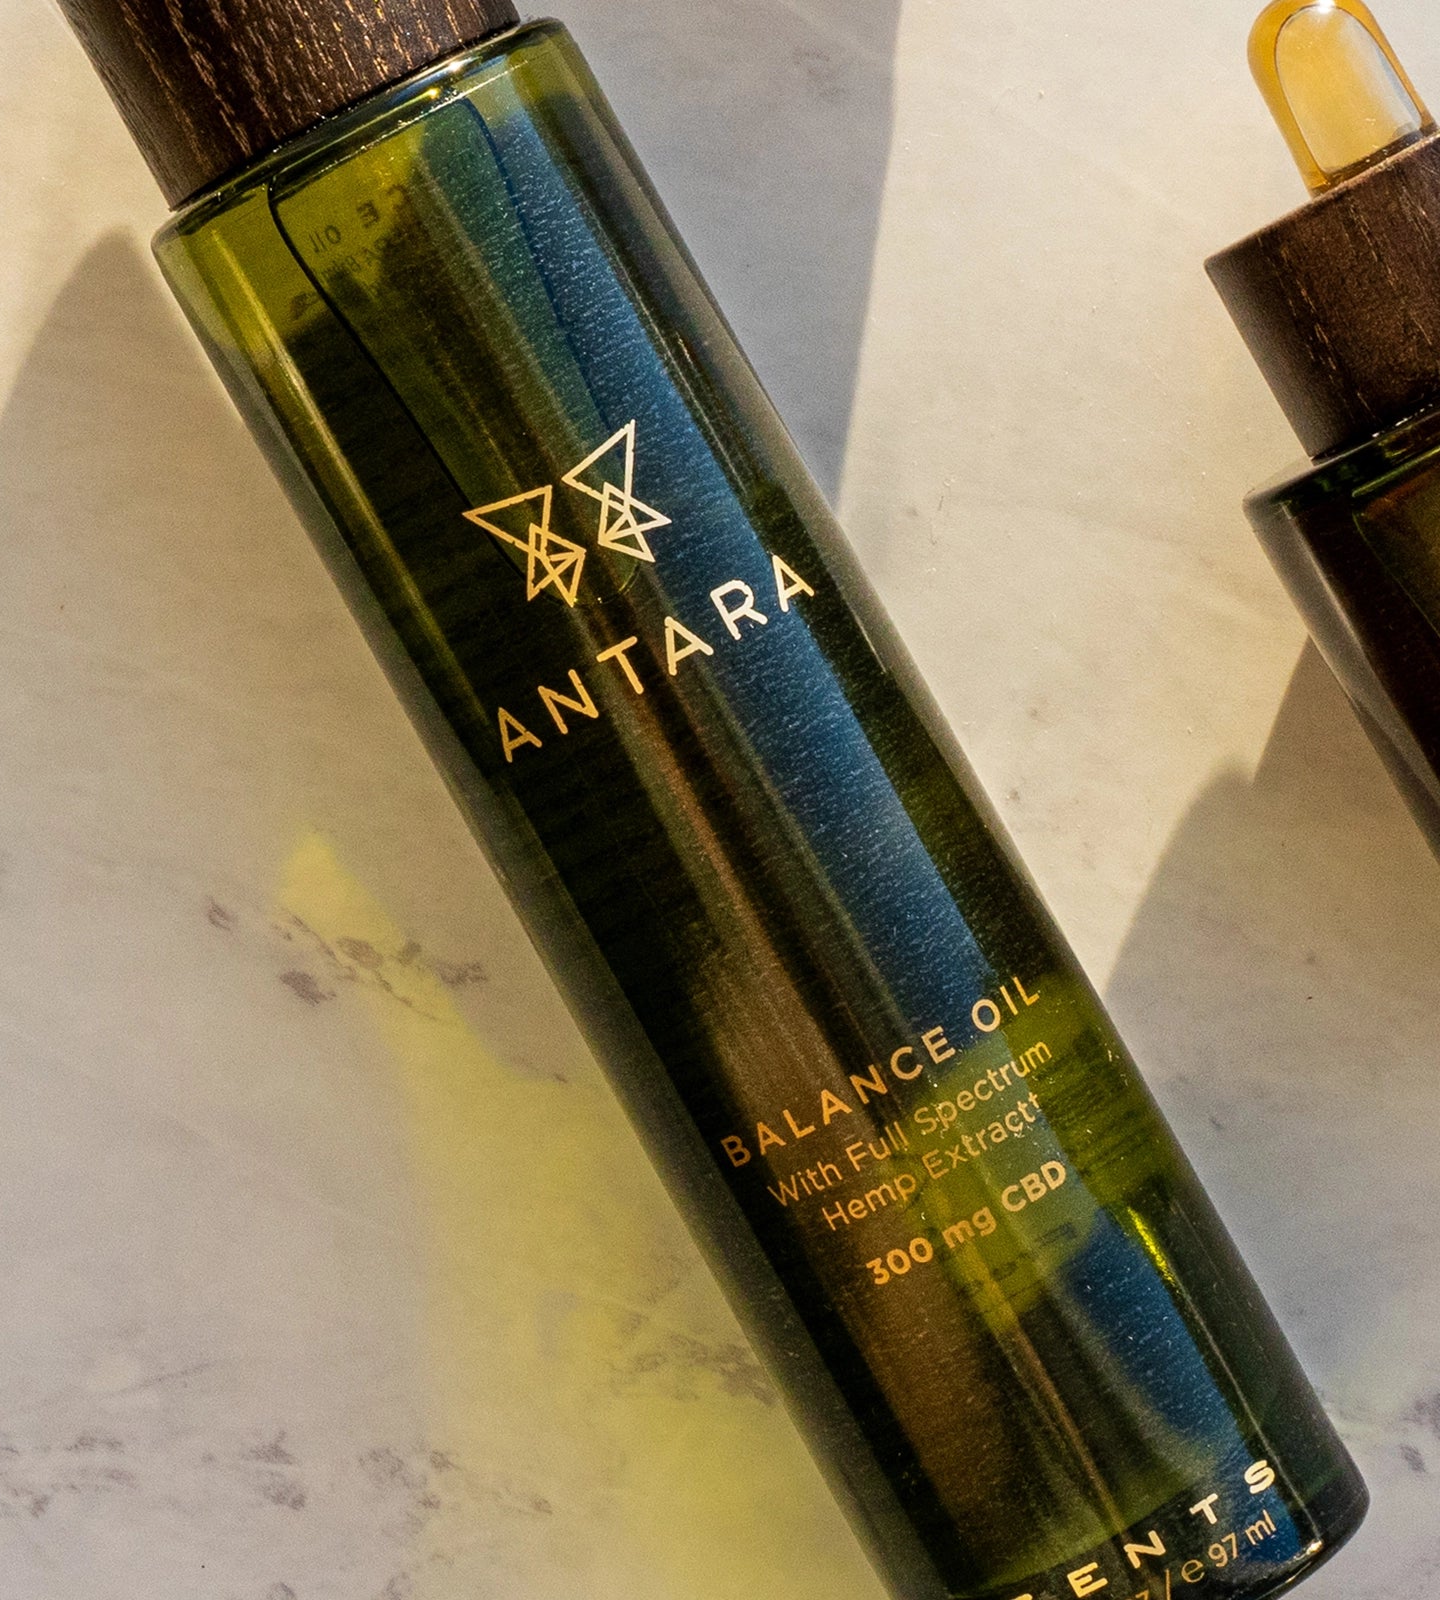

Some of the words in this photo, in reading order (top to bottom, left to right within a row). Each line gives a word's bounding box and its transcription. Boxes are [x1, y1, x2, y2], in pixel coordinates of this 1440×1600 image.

[498, 554, 815, 762] ANTARA
[720, 1025, 957, 1169] BALANCE
[971, 975, 1041, 1033] OIL
[766, 1158, 844, 1208] With
[845, 1121, 909, 1173] Full
[913, 1039, 1053, 1136] Spectrum
[821, 1170, 917, 1232] Hemp
[865, 1236, 935, 1286] 300
[942, 1204, 997, 1250] mg
[1001, 1159, 1068, 1213] CBD
[1010, 1460, 1276, 1600] ENTS
[1208, 1532, 1239, 1568] 97
[1245, 1509, 1278, 1547] ml
